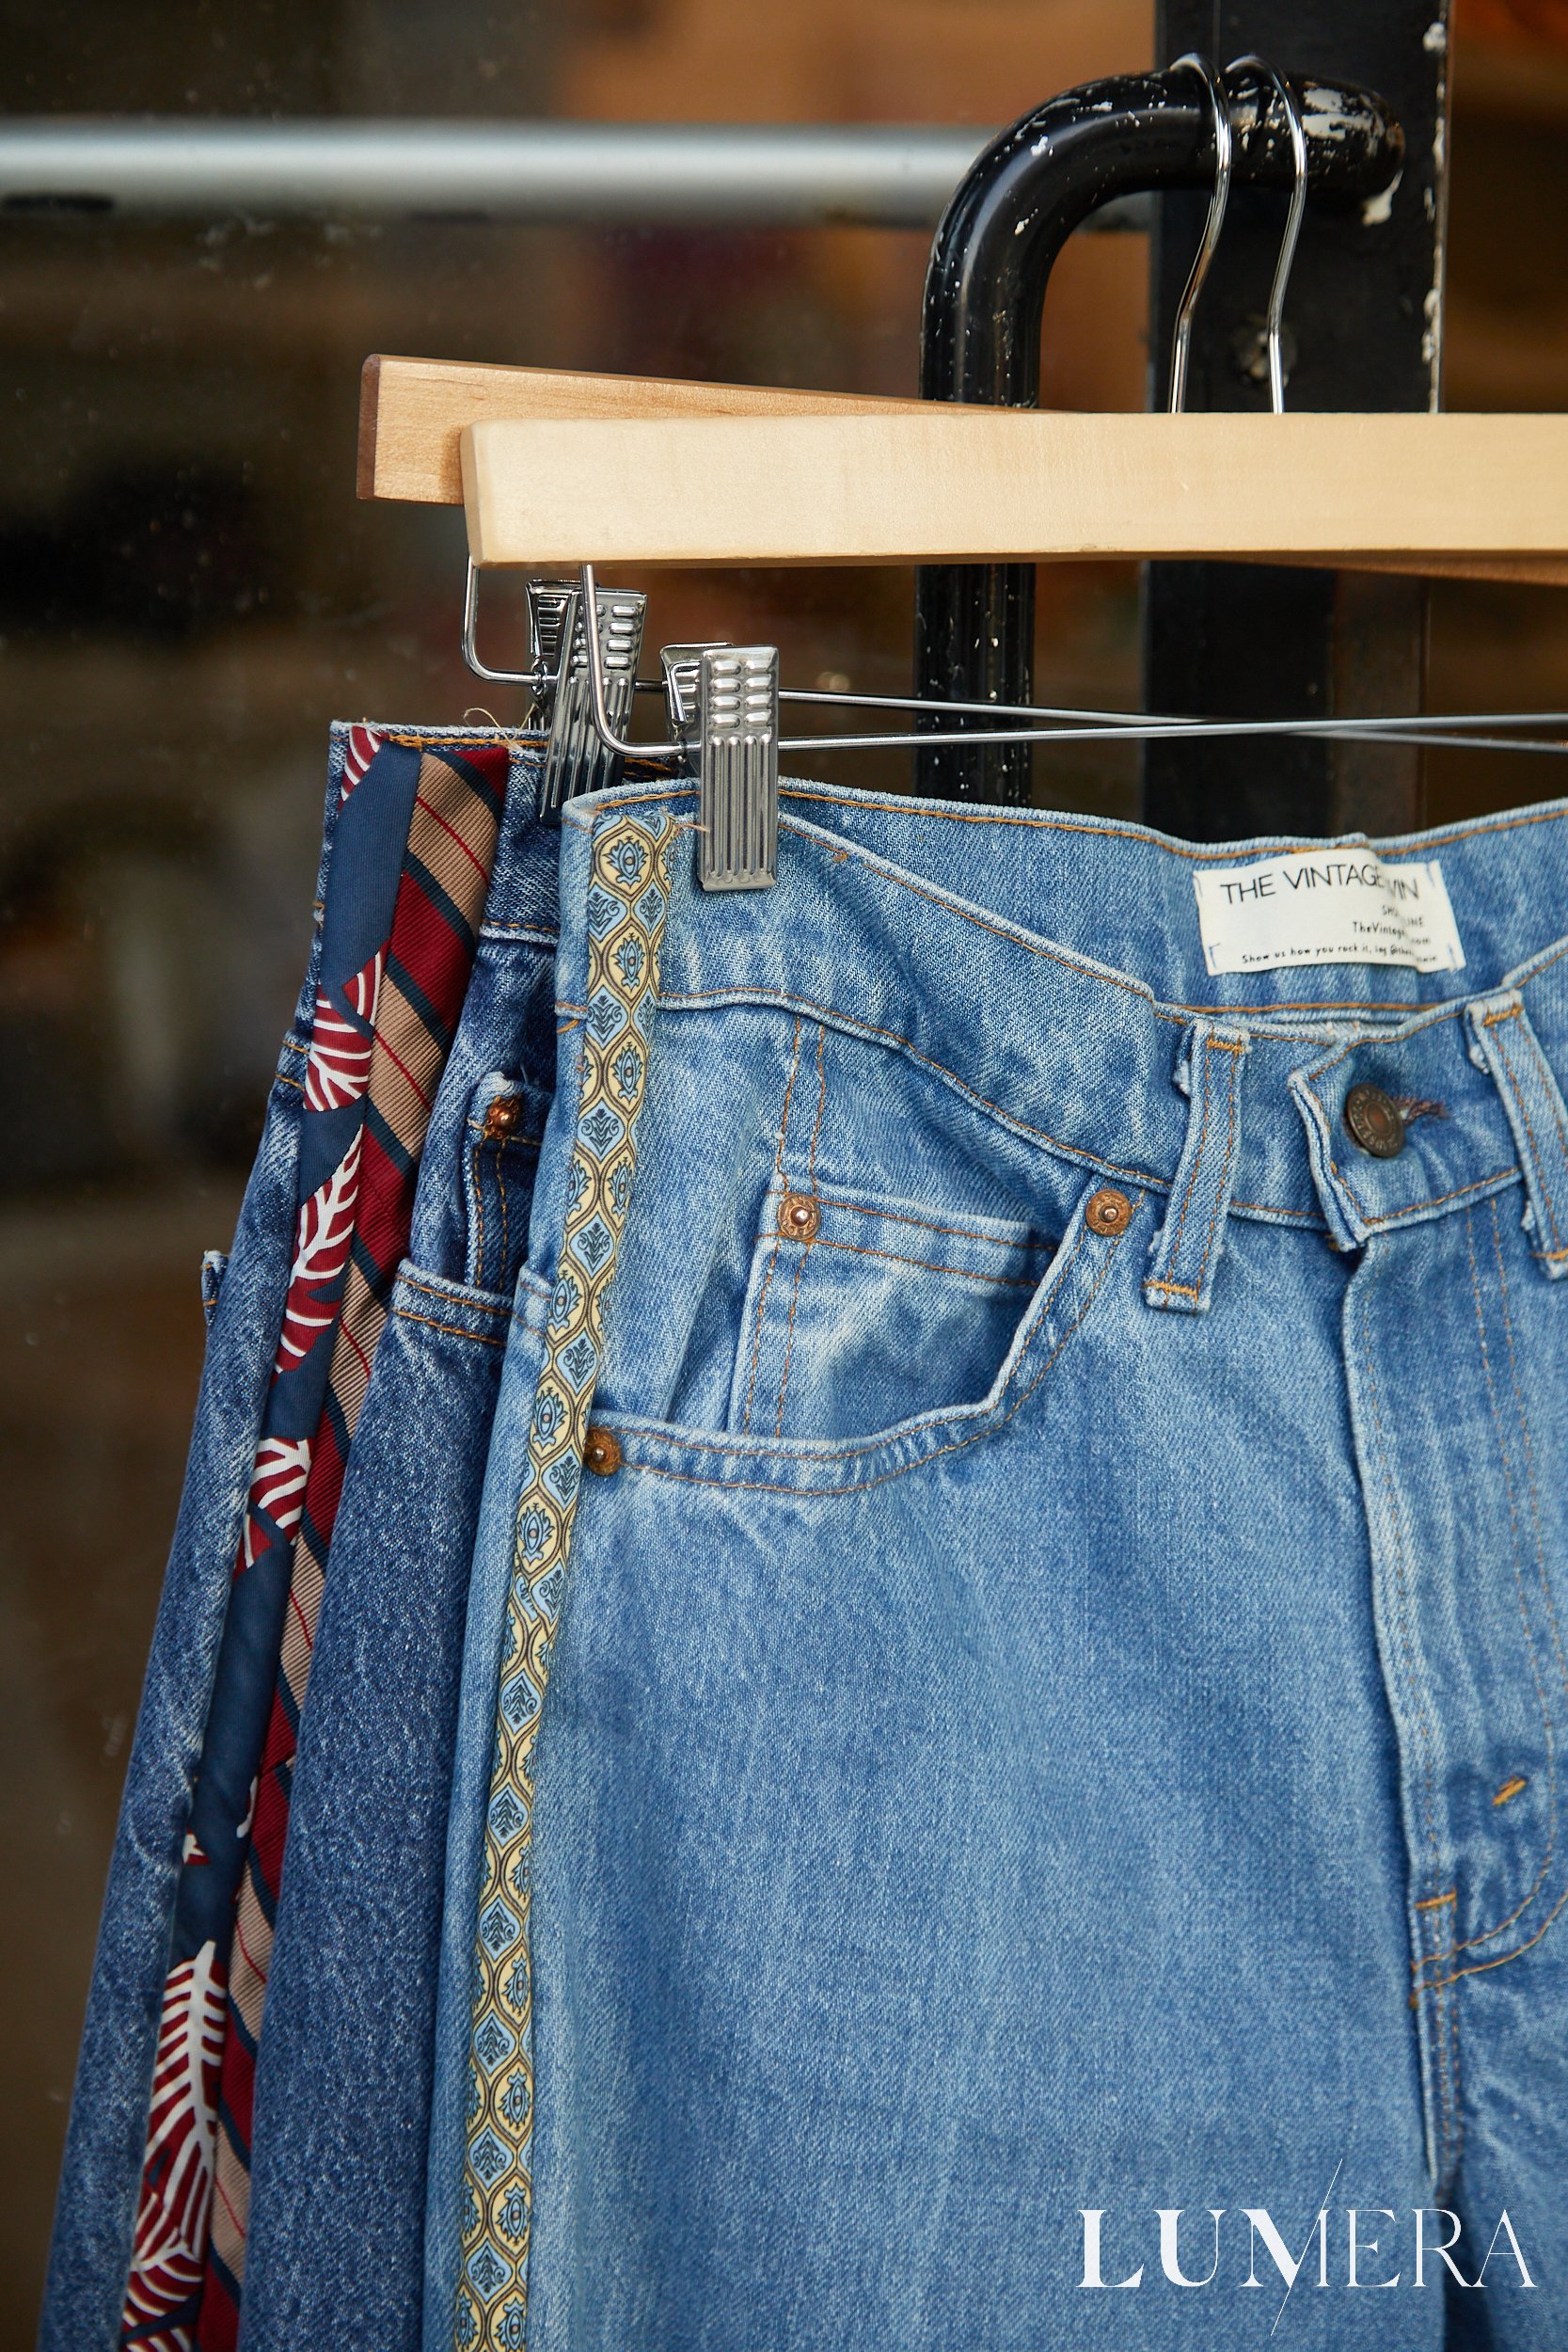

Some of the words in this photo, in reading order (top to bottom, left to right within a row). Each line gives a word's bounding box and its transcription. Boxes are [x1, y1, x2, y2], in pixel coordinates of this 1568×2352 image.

[1219, 873, 1276, 904] THE
[1282, 864, 1386, 890] VINTAGE
[1242, 954, 1270, 964] Show
[1291, 946, 1311, 956] how
[1316, 946, 1334, 957] you
[1338, 943, 1358, 953] rock
